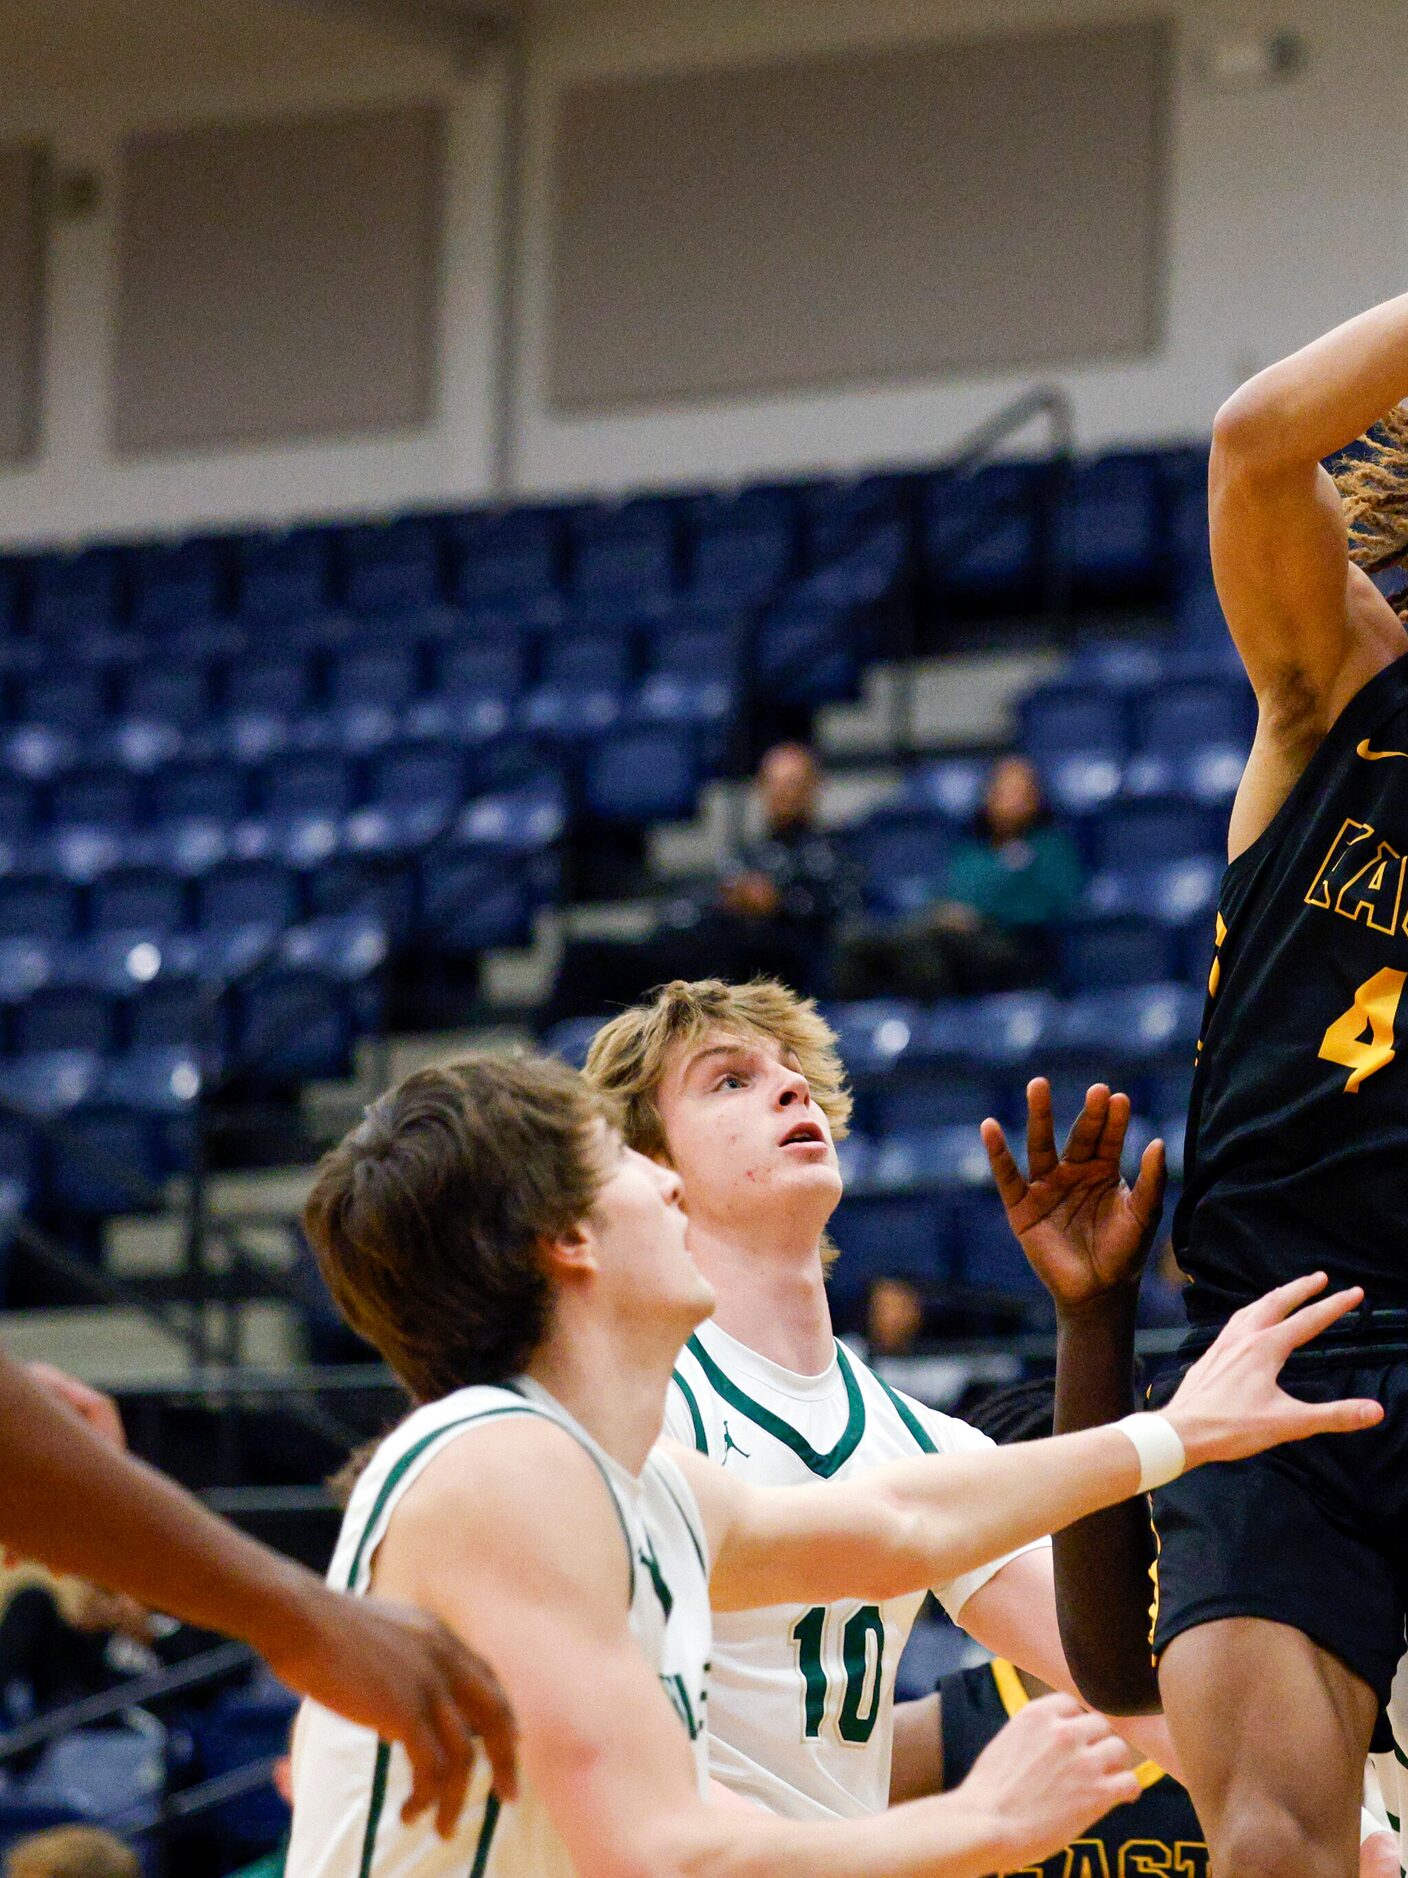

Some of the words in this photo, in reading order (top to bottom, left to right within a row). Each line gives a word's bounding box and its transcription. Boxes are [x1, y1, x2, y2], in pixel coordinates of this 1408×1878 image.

[1317, 966, 1408, 1093] 4
[790, 1603, 886, 1746] 10
[1018, 1838, 1210, 1878] AST
